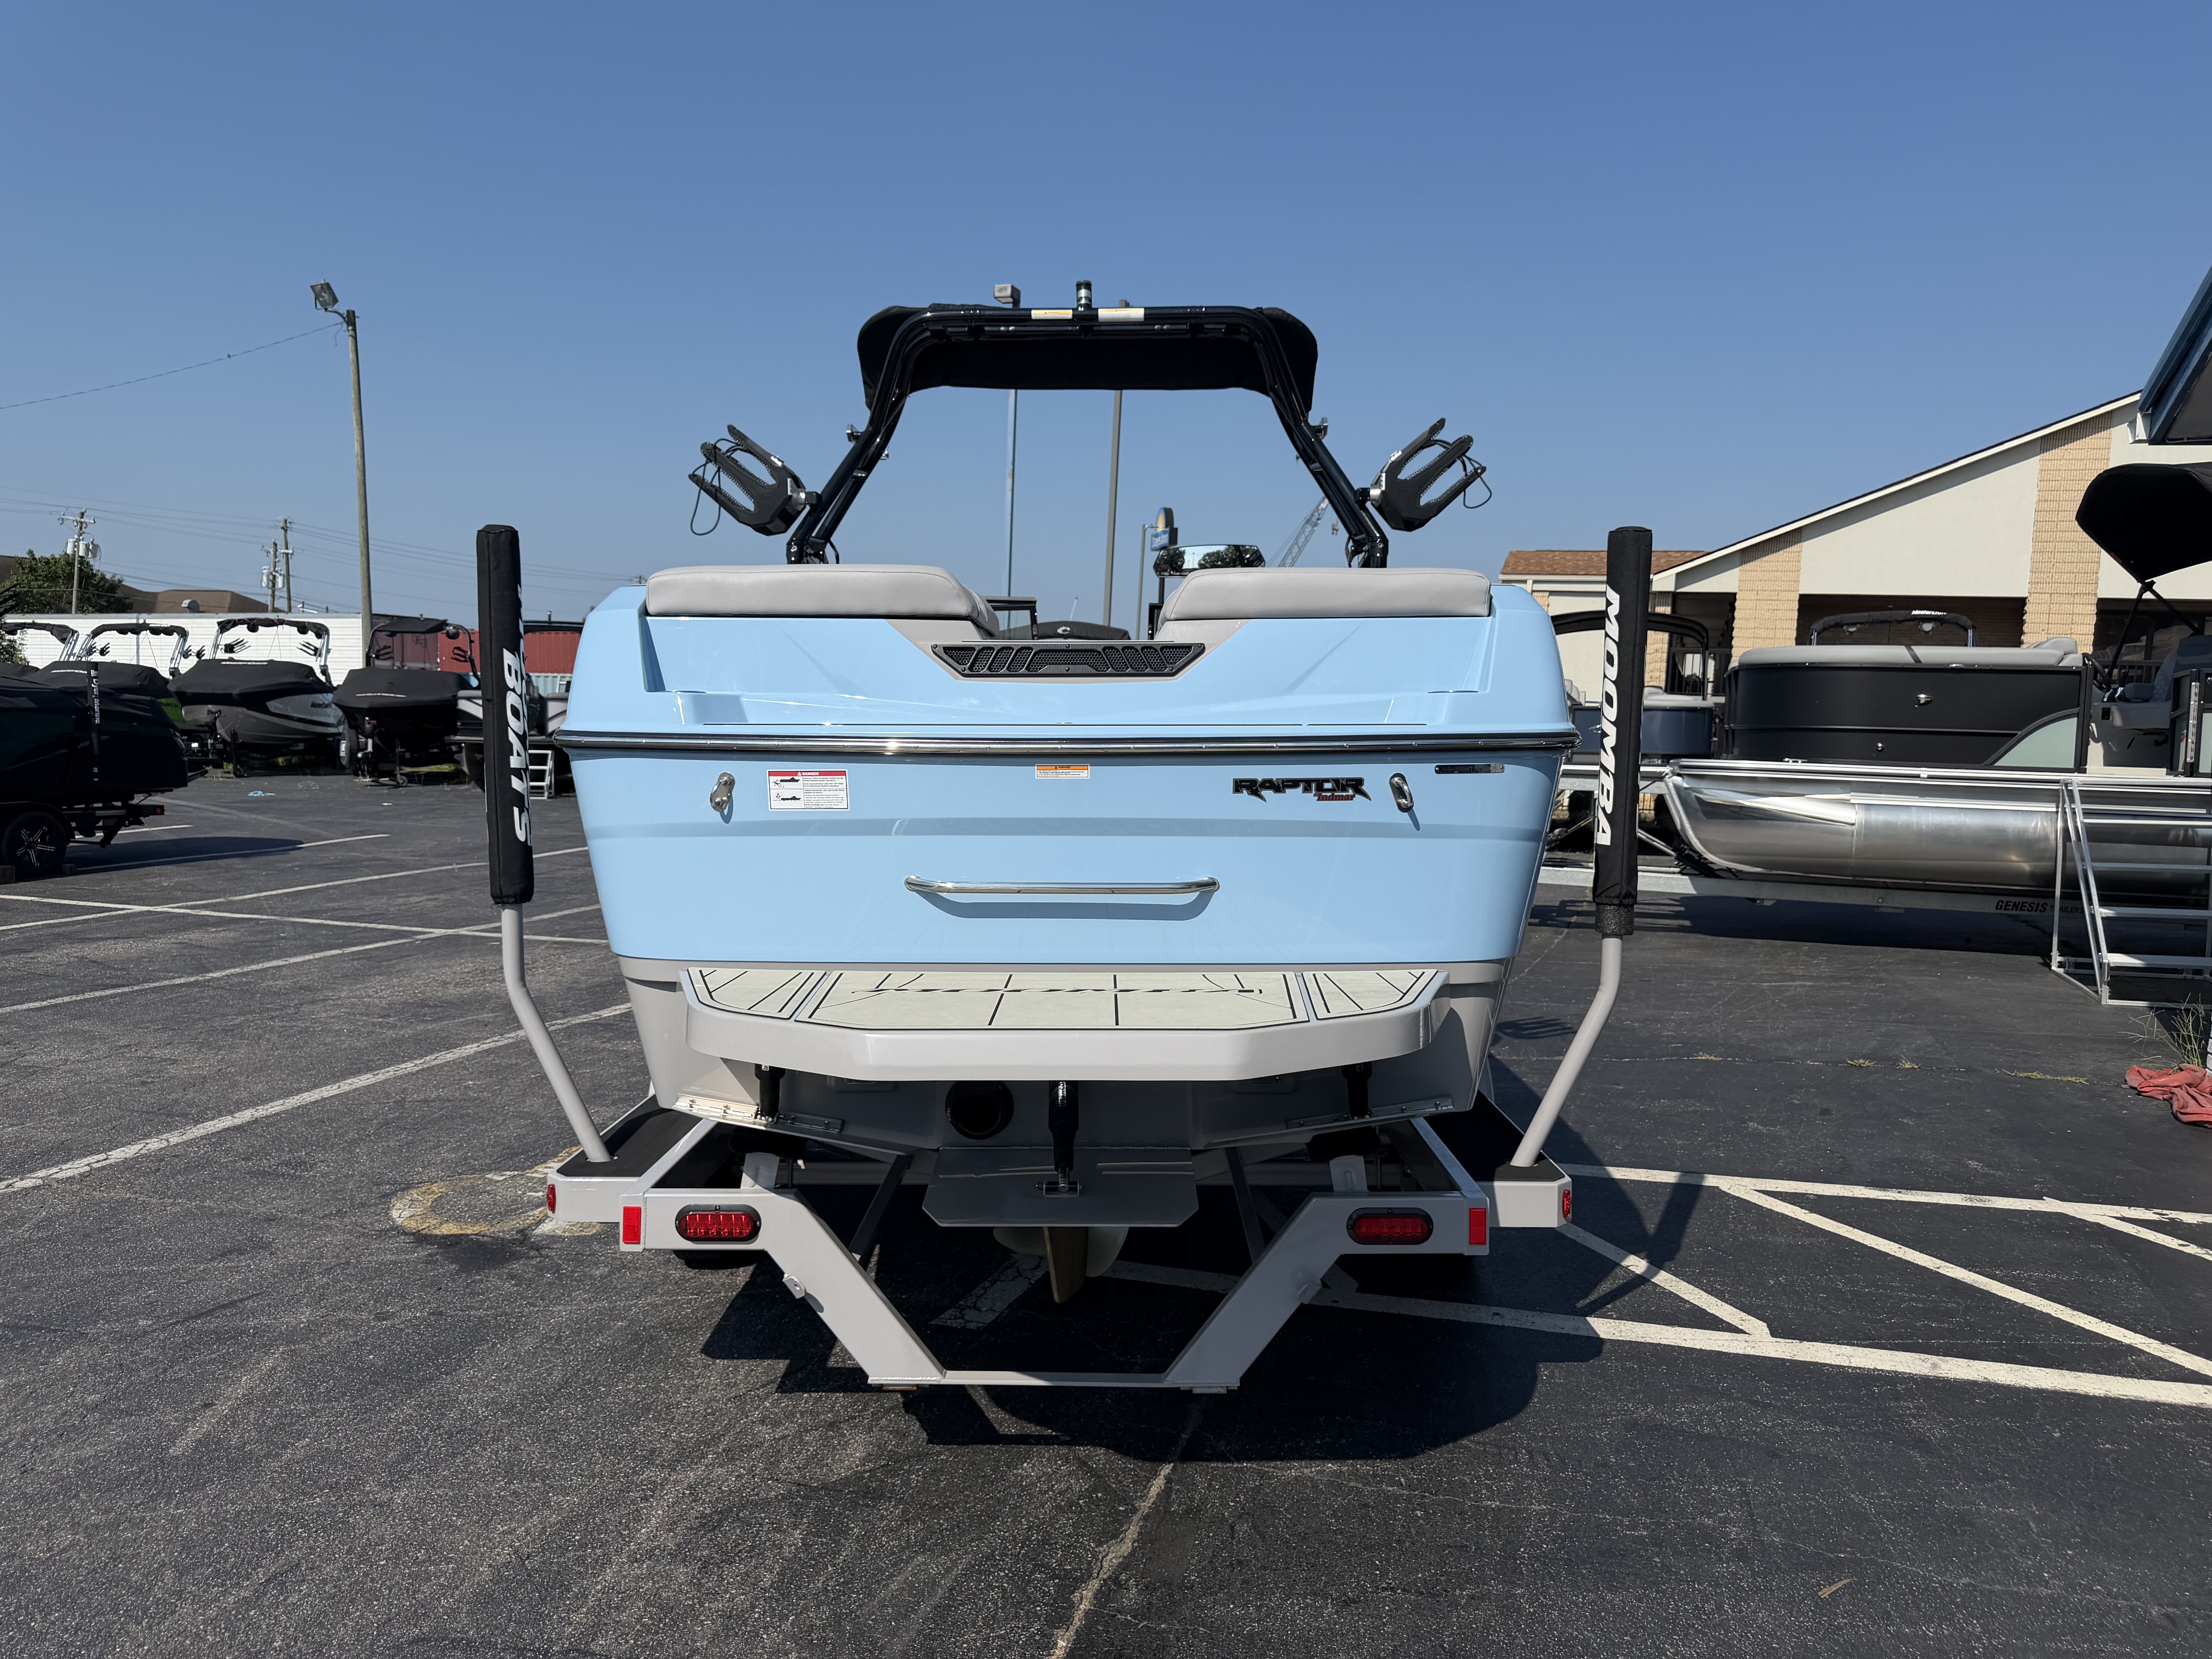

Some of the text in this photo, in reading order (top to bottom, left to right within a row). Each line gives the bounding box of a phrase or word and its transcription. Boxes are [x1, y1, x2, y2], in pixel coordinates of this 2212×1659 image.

[503, 647, 531, 847] BOATS
[1597, 584, 1620, 845] MOOMBA
[1233, 778, 1372, 802] RAPTOR
[1996, 900, 2048, 913] GENESIS
